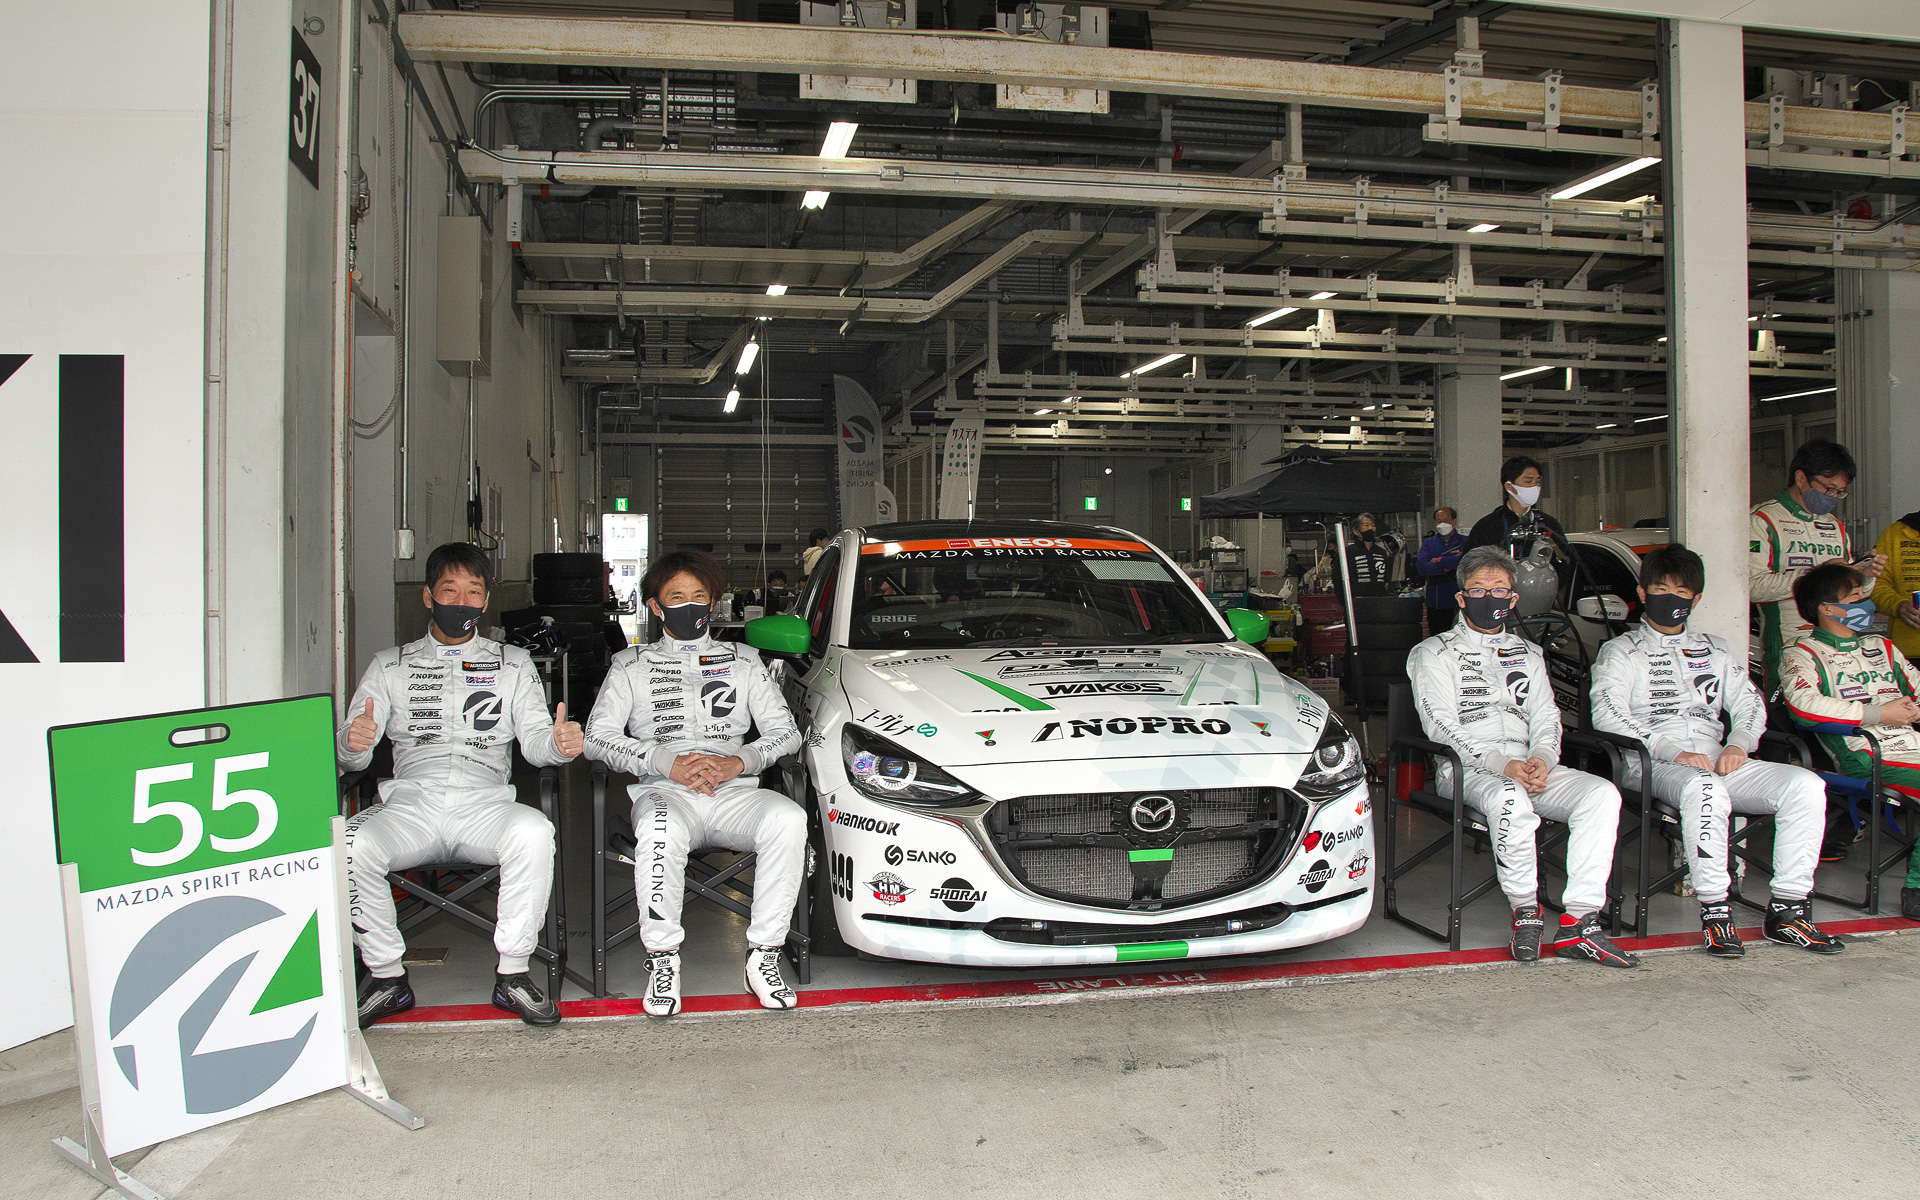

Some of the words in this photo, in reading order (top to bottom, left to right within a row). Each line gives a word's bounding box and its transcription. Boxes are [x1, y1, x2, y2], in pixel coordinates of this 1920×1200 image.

[294, 59, 320, 161] 37
[972, 538, 1073, 548] ENEOS
[896, 549, 974, 560] MAZDA
[983, 548, 1045, 557] SPIRIT
[1055, 548, 1131, 558] RACING
[871, 614, 917, 624] BRIDE
[872, 655, 953, 668] Garrett
[1068, 717, 1231, 739] NOPRO
[1434, 719, 1452, 736] SPIRIT
[1450, 733, 1475, 754] RACING
[130, 750, 279, 868] 55
[1700, 783, 1713, 841] RACING
[1337, 825, 1364, 844] SANKO
[1497, 799, 1515, 853] RACING
[906, 849, 957, 866] SANKO
[651, 841, 666, 903] RACING
[1297, 867, 1337, 886] SHORAI
[96, 884, 174, 913] MAZDA
[181, 871, 240, 895] SPIRIT
[249, 856, 320, 882] RACING
[879, 882, 901, 895] HM
[879, 893, 902, 902] RACERS
[929, 888, 988, 902] SHORAI
[1034, 977, 1126, 992] LANE
[1156, 972, 1207, 984] PIT
